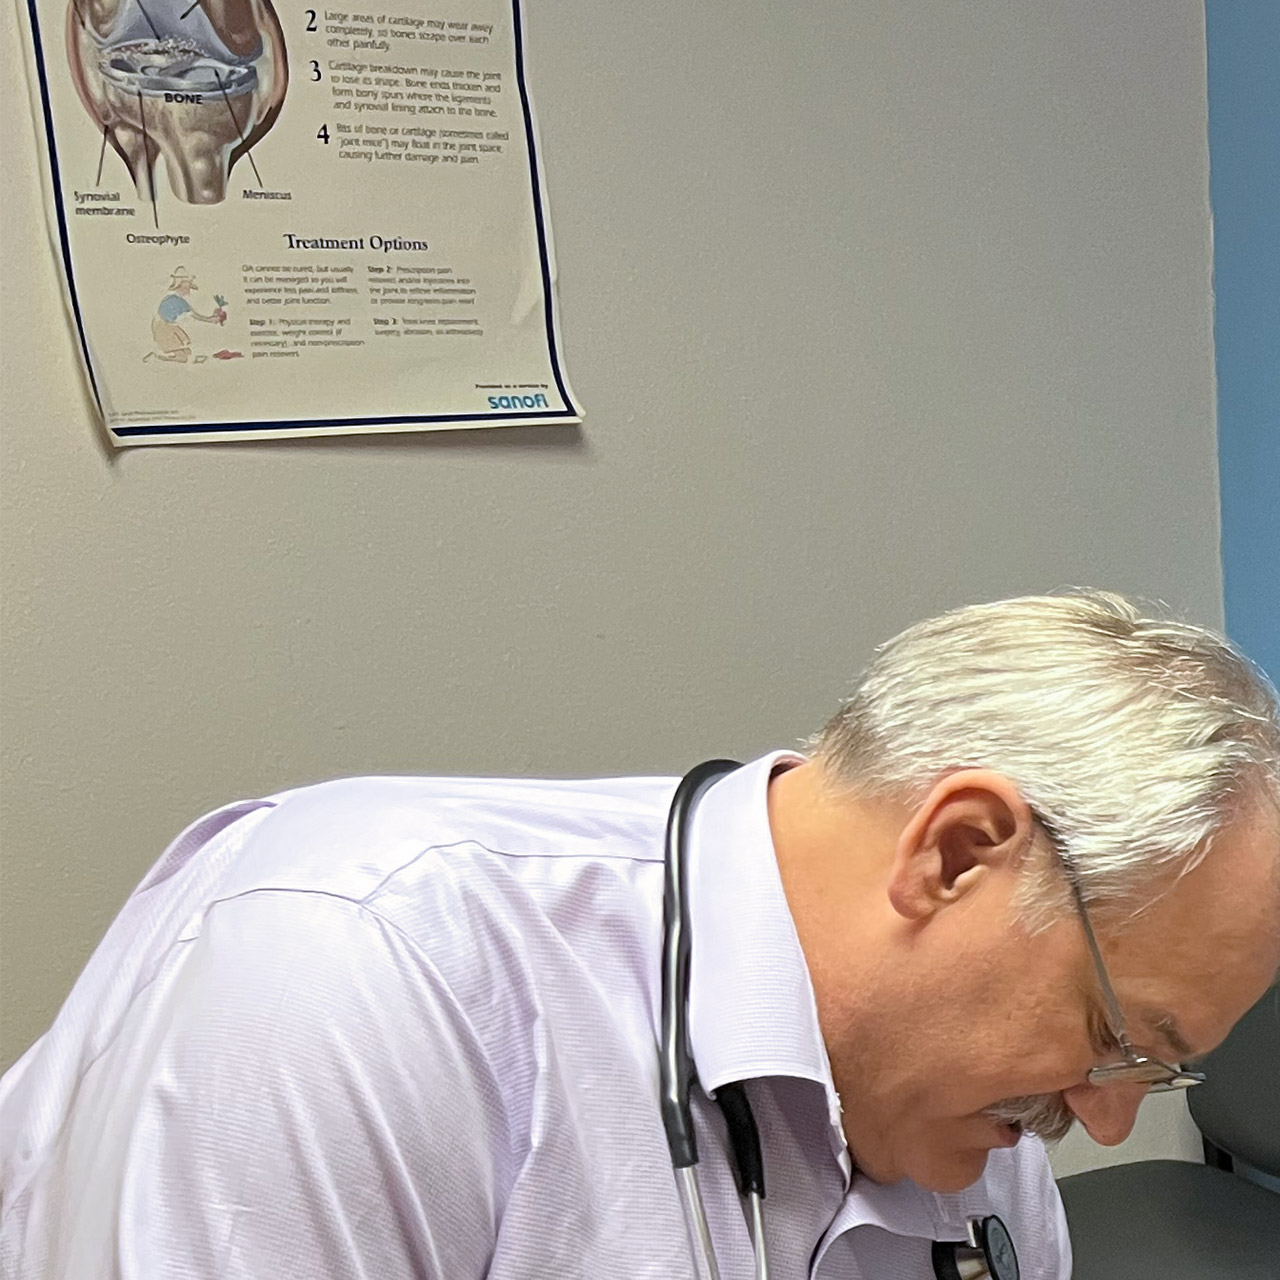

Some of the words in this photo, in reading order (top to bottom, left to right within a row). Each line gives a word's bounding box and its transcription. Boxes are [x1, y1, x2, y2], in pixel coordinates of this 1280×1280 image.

[305, 9, 318, 32] 2
[309, 59, 322, 82] 3
[164, 92, 203, 105] BONE
[317, 123, 330, 145] 4
[75, 206, 136, 217] membrane
[126, 233, 190, 246] Osteophyte
[283, 233, 365, 250] Treatment
[370, 235, 429, 253] Options
[488, 393, 548, 409] sanofi
